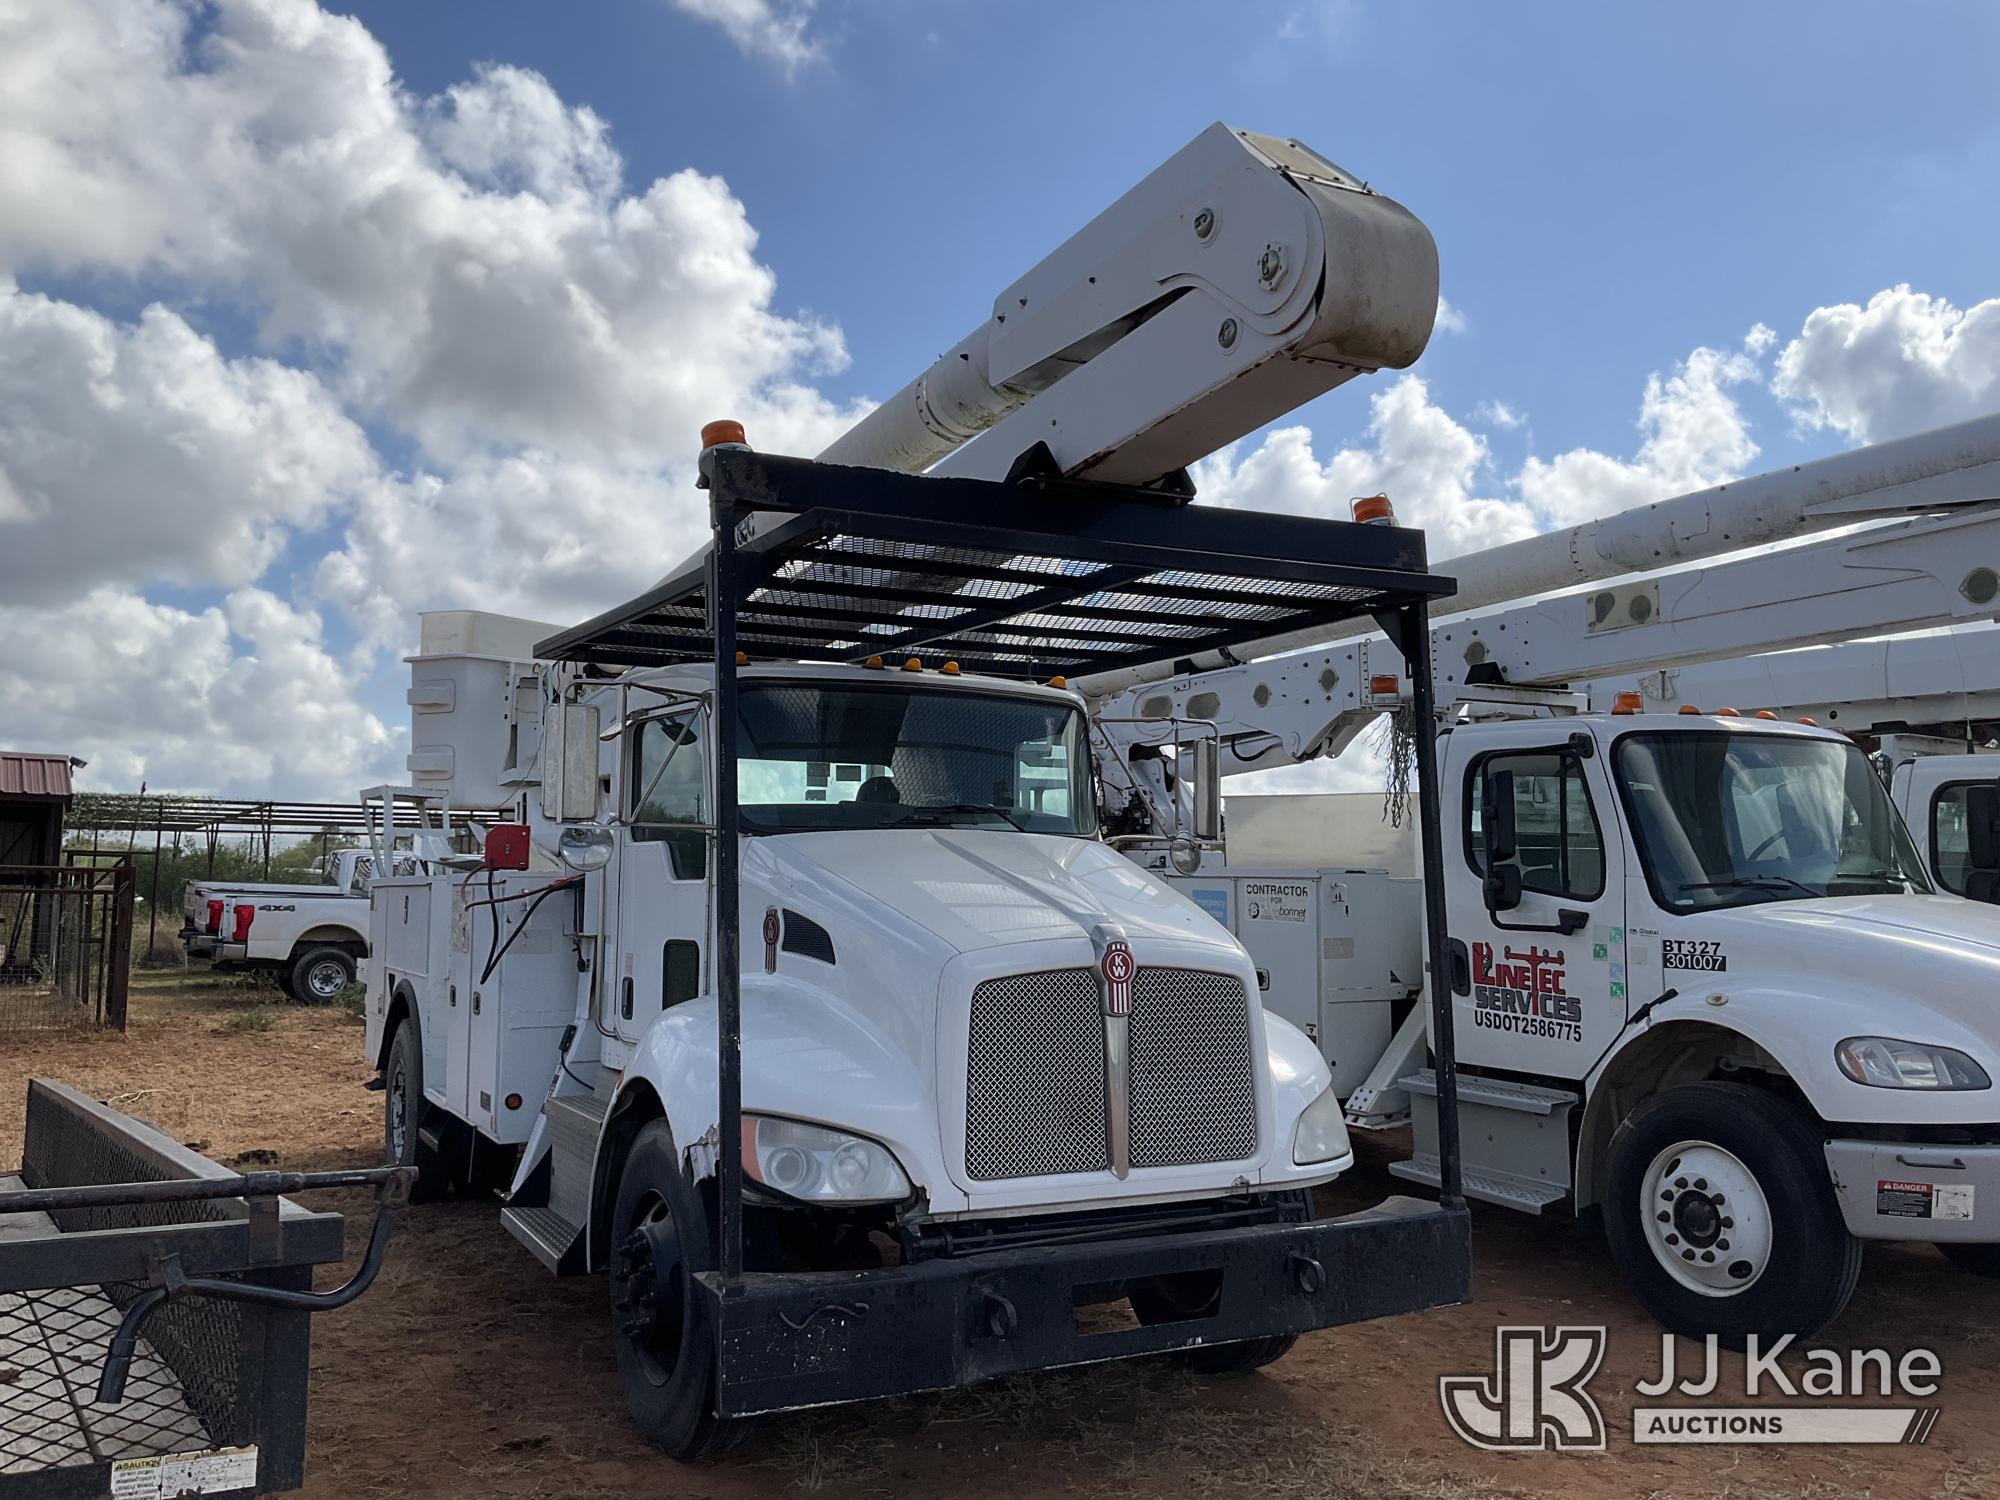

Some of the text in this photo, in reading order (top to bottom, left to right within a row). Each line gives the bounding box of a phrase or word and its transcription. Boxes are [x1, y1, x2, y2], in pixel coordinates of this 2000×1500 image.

[1246, 884, 1308, 897] CONTRACTOR
[1271, 896, 1283, 904] FOR
[1638, 928, 1660, 936] Global
[1662, 940, 1721, 956] BT327
[1666, 954, 1723, 971] 301007
[1474, 985, 1583, 1023] SERVICES
[1474, 1010, 1583, 1042] USDOT2586775
[1893, 1183, 1927, 1193] DANGER
